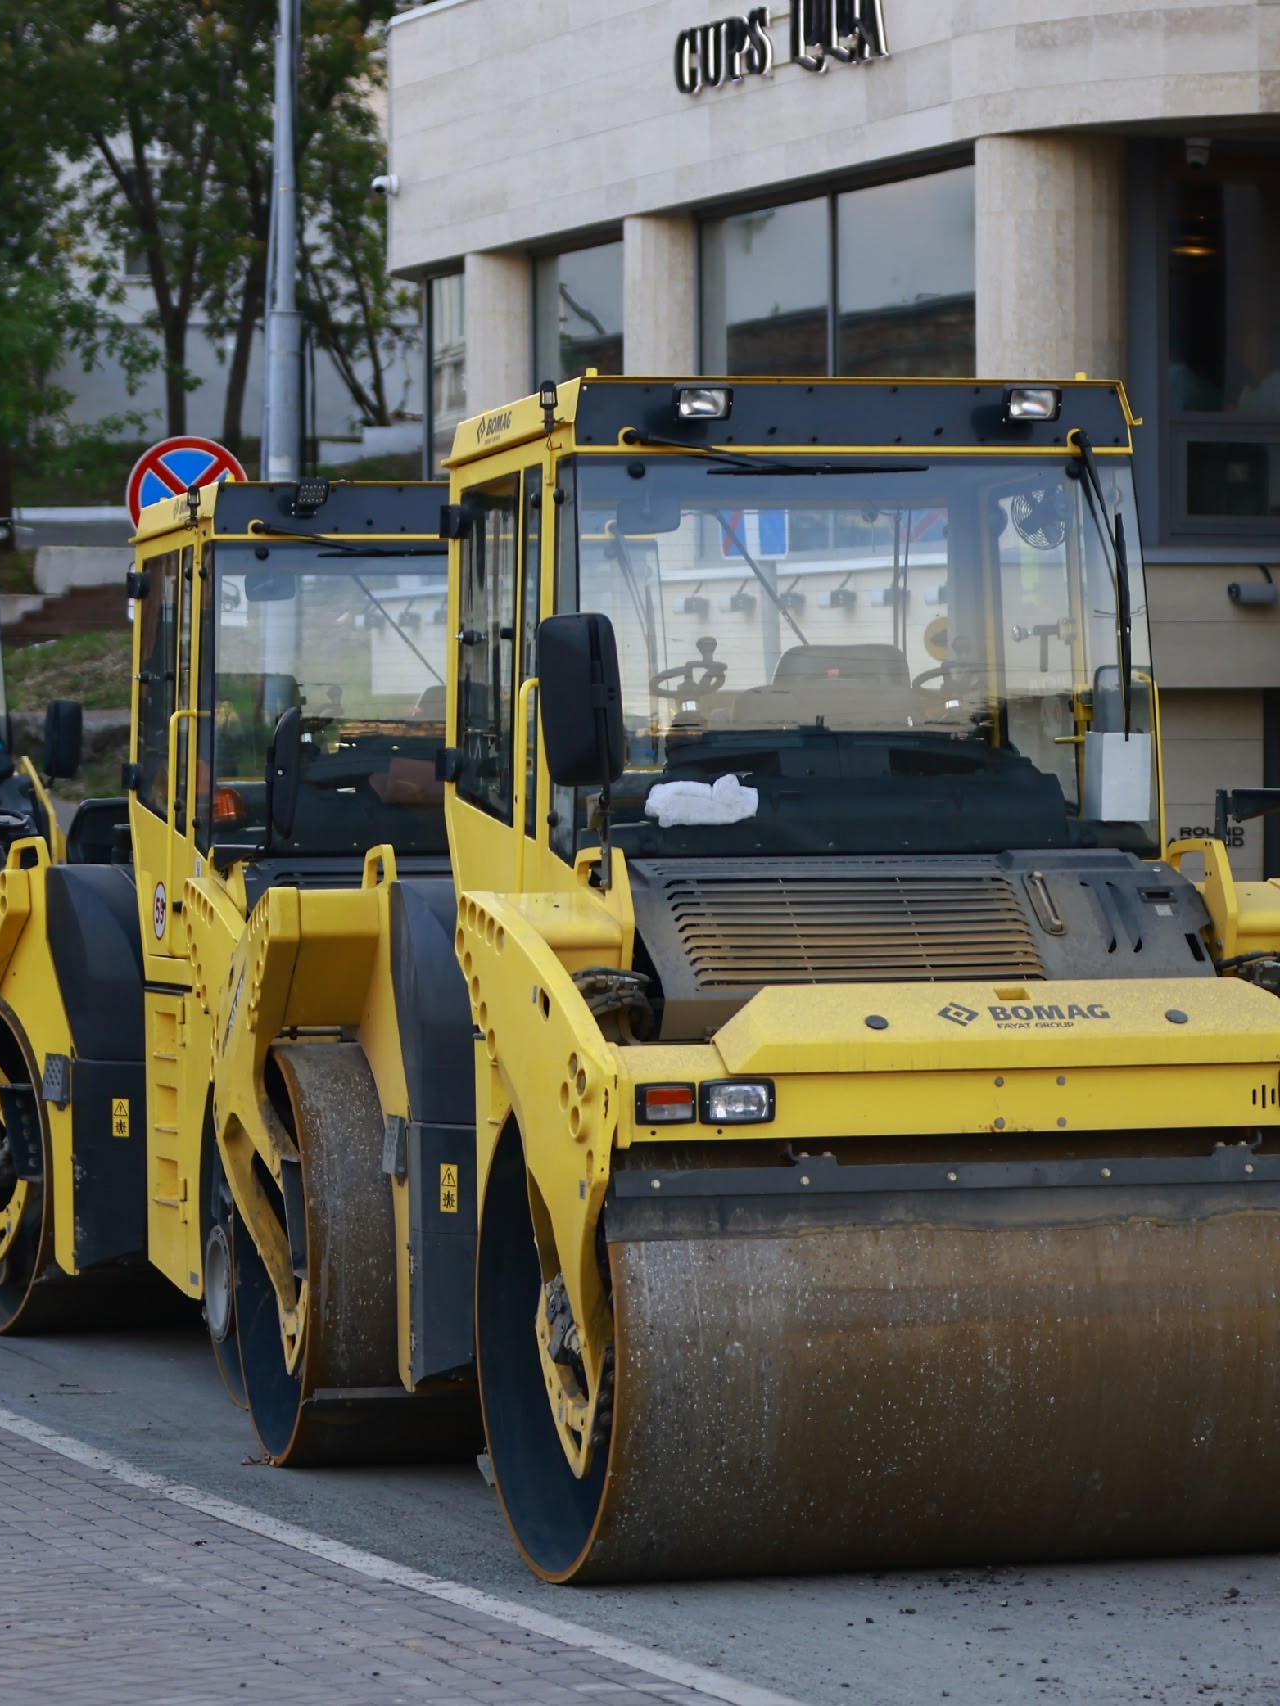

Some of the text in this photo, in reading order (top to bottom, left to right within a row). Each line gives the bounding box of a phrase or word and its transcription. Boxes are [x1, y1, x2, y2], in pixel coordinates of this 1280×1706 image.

[987, 1003, 1111, 1022] BOMAG
[996, 1020, 1075, 1030] FAYAT GROUP
